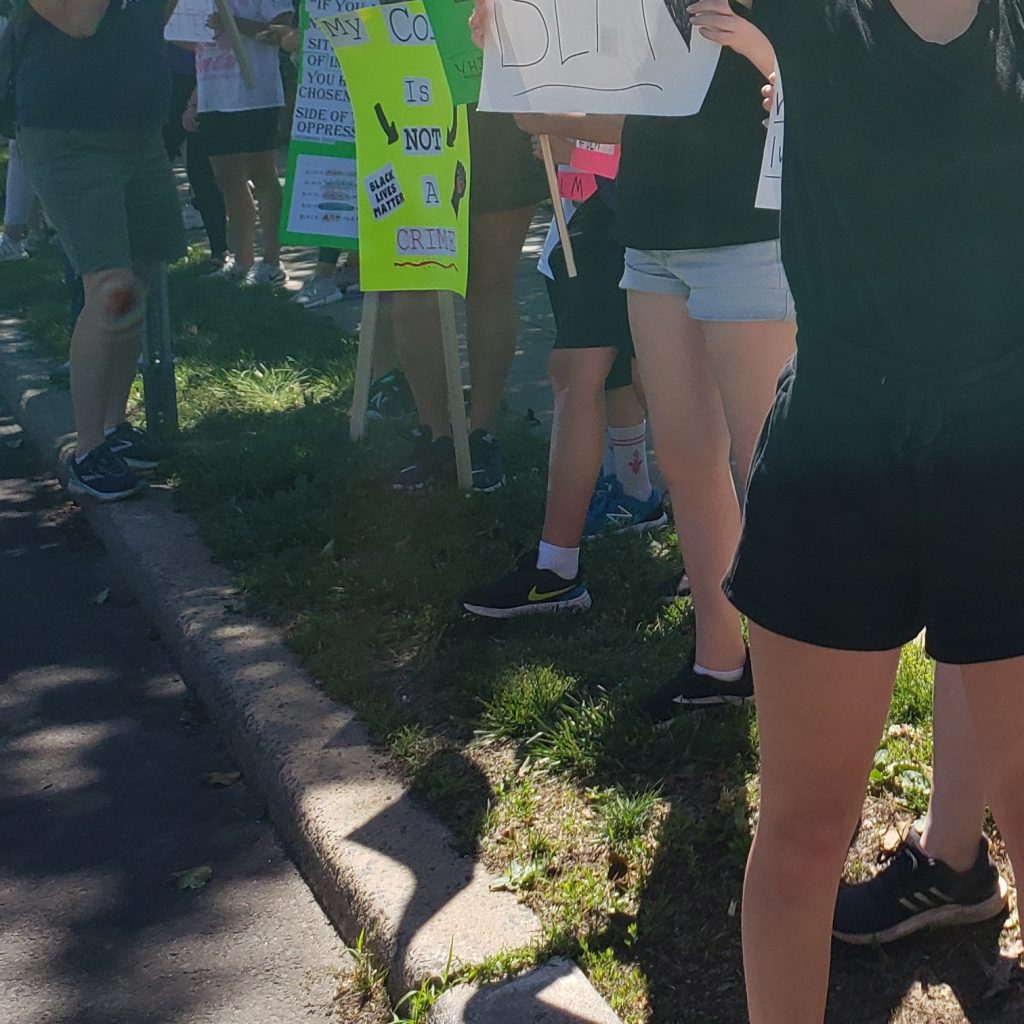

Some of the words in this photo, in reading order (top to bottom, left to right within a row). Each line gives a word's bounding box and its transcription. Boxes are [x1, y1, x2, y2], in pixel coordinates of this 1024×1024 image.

[389, 8, 435, 42] Co
[308, 70, 334, 85] YOU
[295, 106, 327, 120] SIDE
[330, 110, 348, 122] OF
[404, 128, 441, 150] NOT
[369, 169, 395, 192] BLACK
[375, 183, 397, 203] LIVES
[425, 181, 439, 203] A
[373, 192, 405, 218] MATTER
[396, 228, 456, 252] CRIME
